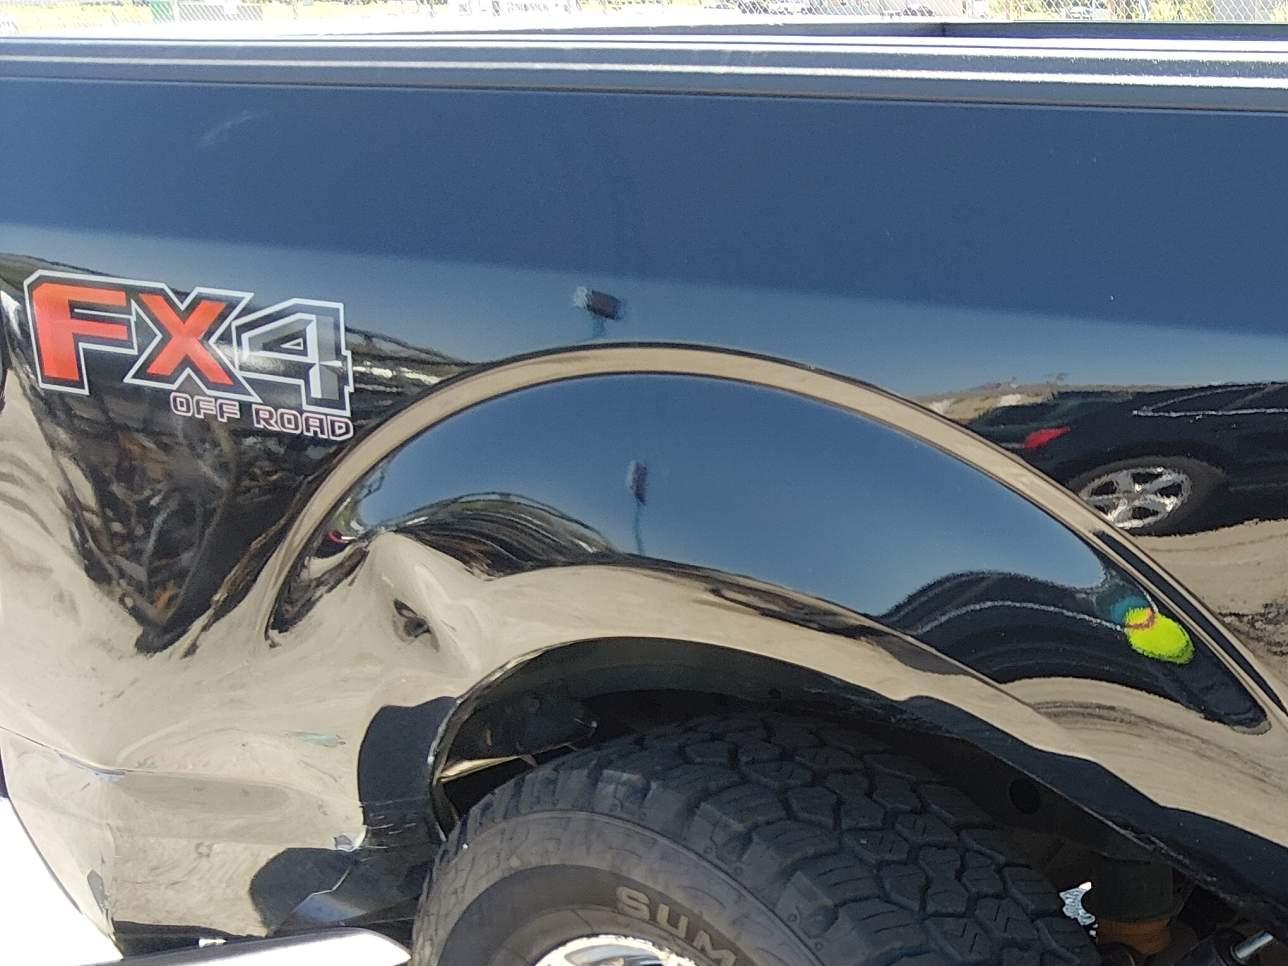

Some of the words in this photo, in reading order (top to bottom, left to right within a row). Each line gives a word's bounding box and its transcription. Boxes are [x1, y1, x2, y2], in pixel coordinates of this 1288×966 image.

[24, 269, 353, 416] FX4
[170, 391, 240, 422] OFF
[251, 405, 354, 440] ROAD
